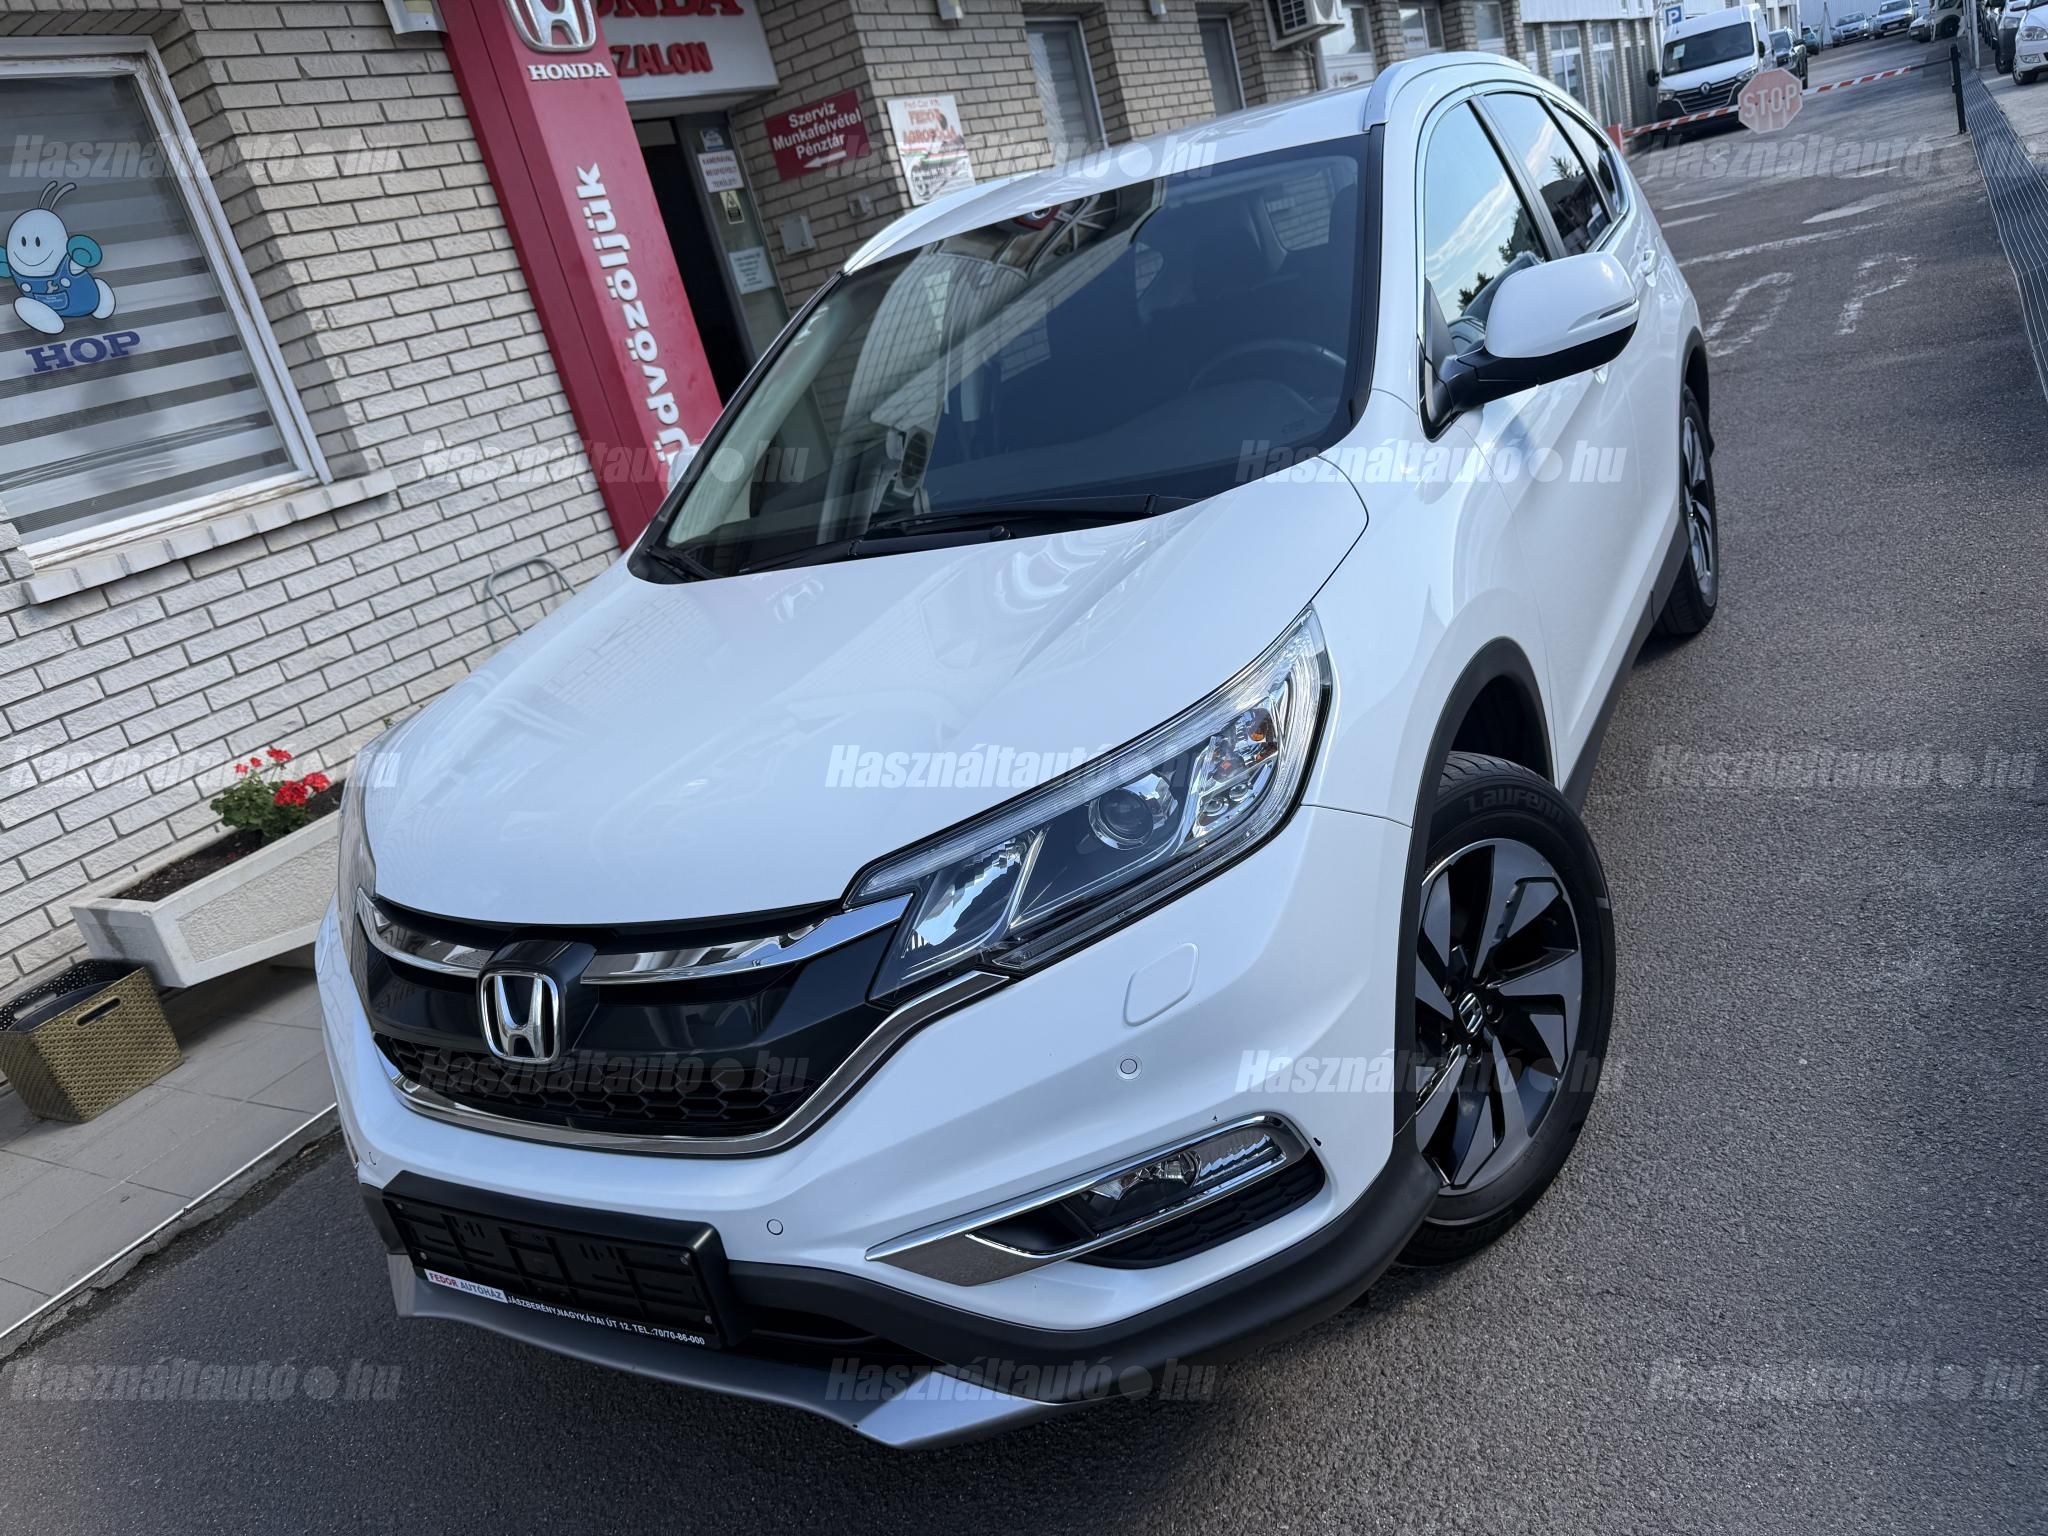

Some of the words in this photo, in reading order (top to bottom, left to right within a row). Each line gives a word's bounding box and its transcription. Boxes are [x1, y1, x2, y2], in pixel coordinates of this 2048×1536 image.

[528, 62, 612, 81] HONDA
[788, 102, 836, 128] Szerviz
[1743, 84, 1798, 118] STOP
[772, 107, 862, 151] Munkafelvétel
[796, 133, 846, 160] Pénztár
[576, 162, 691, 467] Üdvözöljük
[25, 331, 141, 373] HOP
[428, 1272, 458, 1287] FEDOR
[459, 1281, 503, 1299] AUTÓHÁZ
